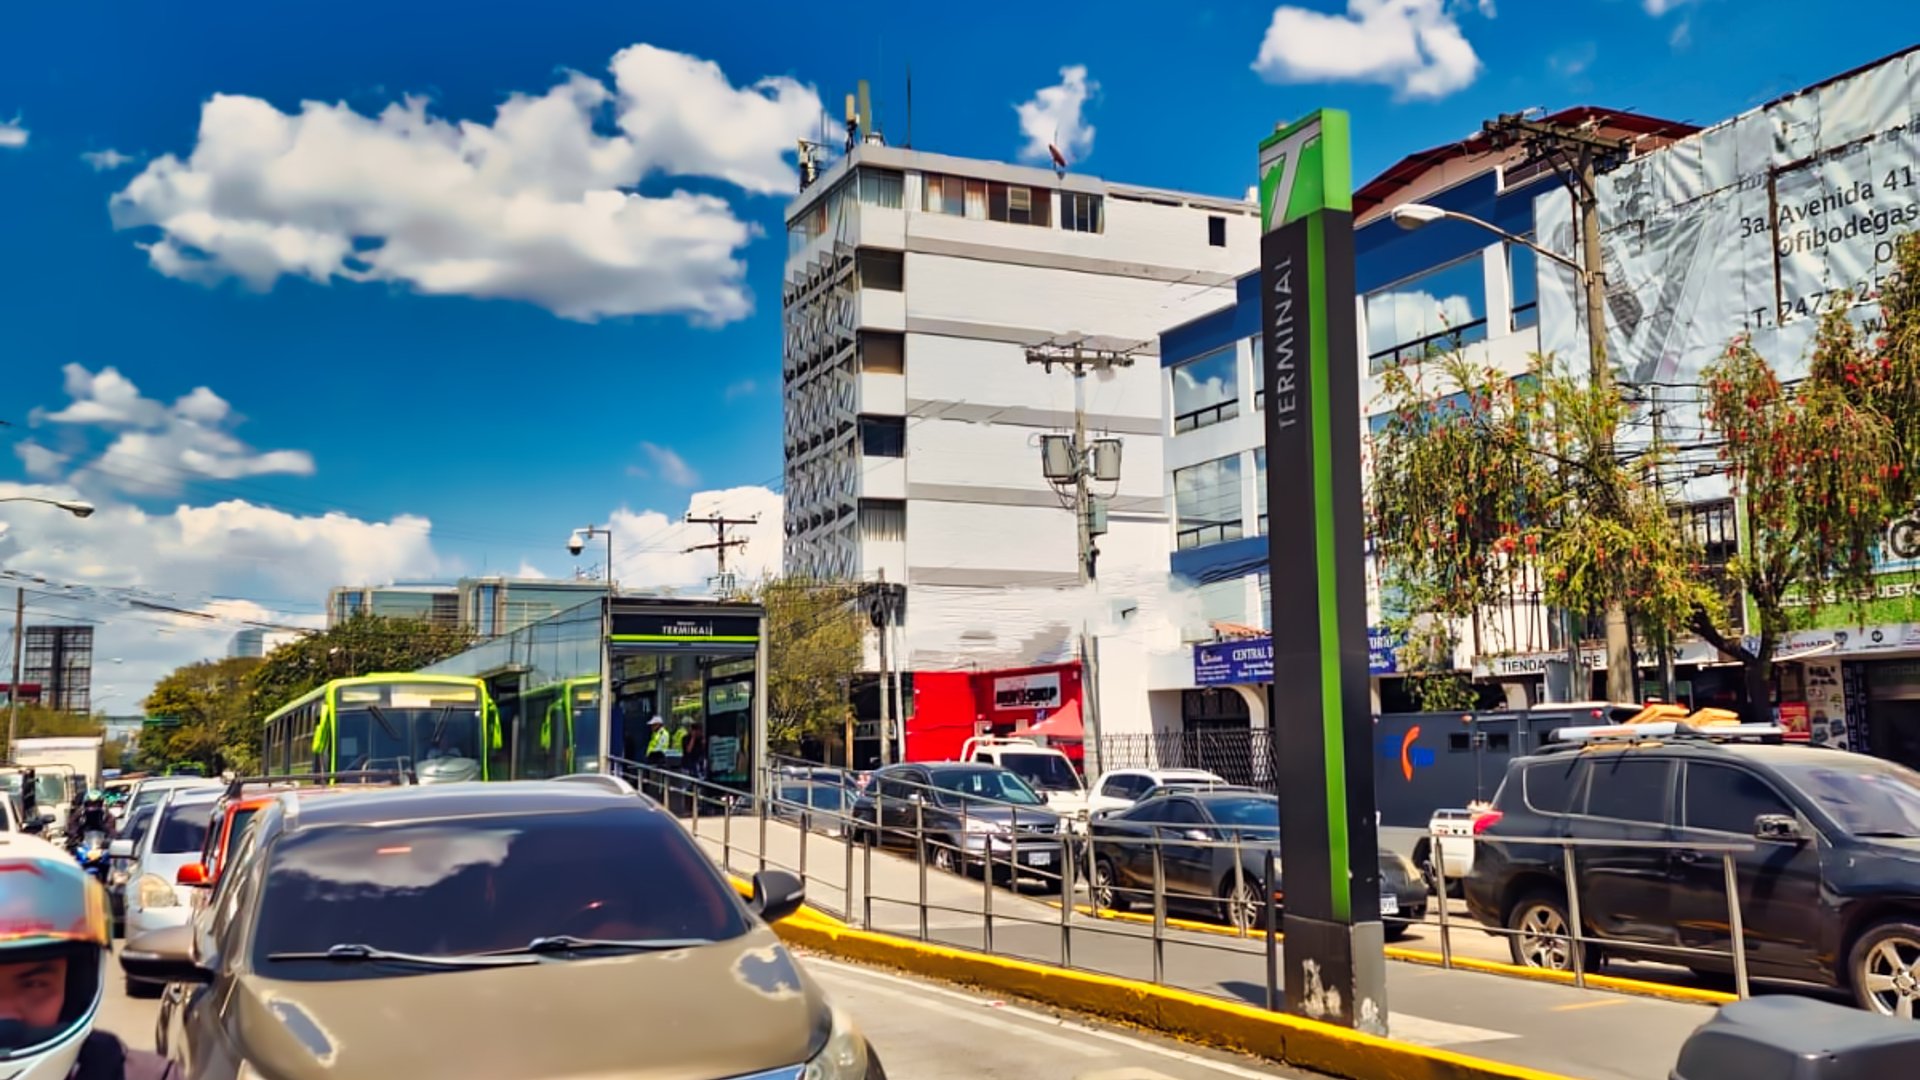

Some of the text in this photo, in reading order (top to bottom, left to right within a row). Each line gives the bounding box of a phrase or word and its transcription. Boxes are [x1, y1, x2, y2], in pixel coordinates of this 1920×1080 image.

[1778, 181, 1875, 227] Avenida
[1274, 255, 1297, 431] TERMINAL
[662, 625, 713, 636] TERMINAL
